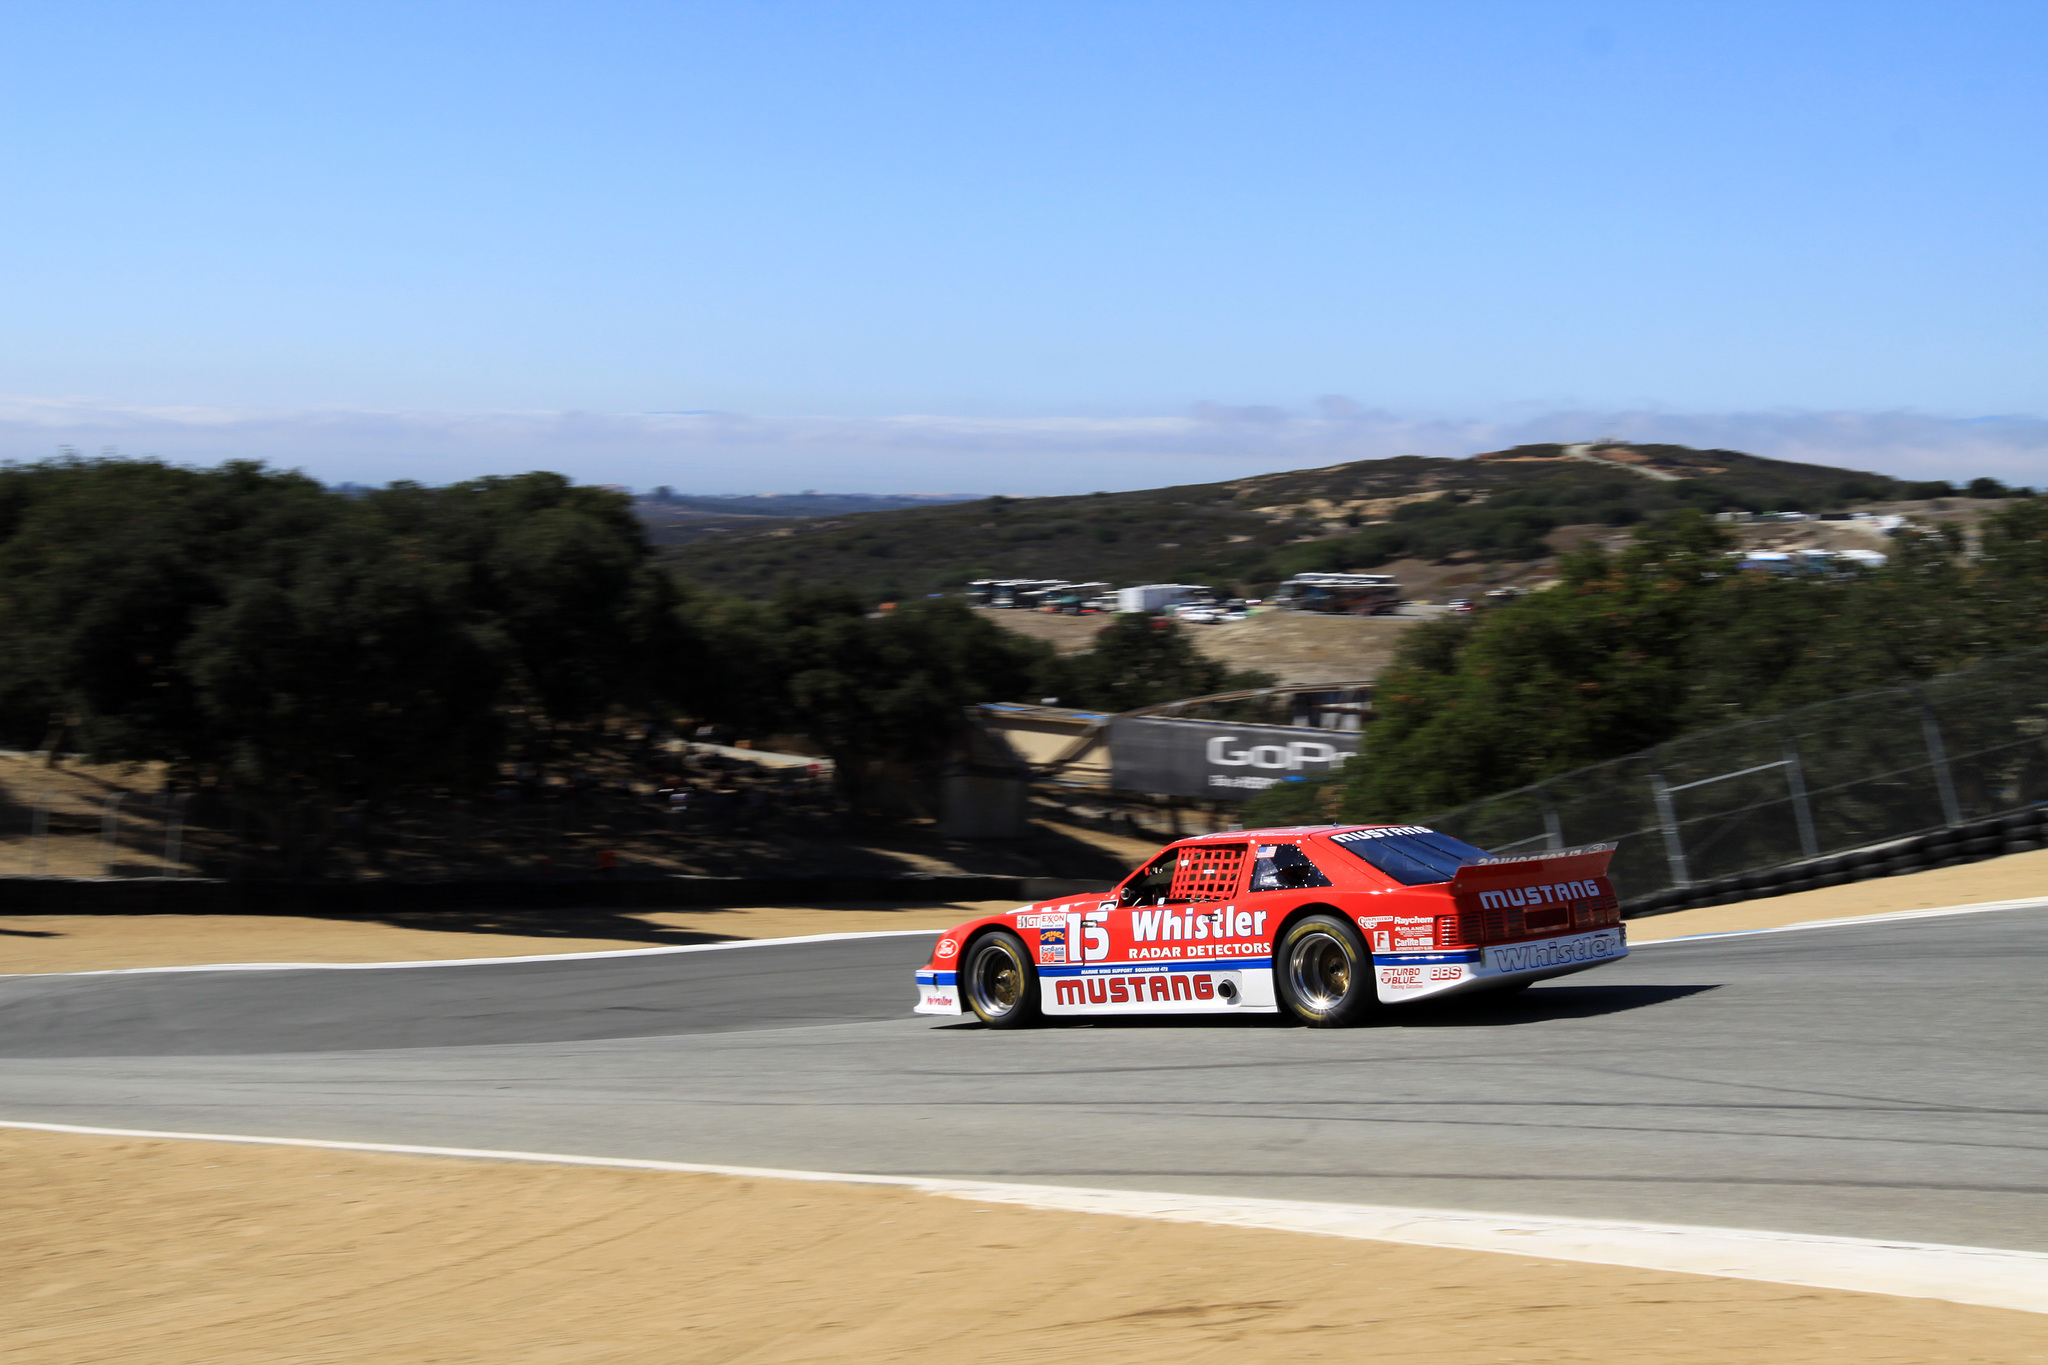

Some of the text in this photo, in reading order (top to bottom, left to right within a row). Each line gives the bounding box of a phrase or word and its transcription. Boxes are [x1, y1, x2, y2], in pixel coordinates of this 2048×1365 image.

[1331, 827, 1433, 843] MUSTANG
[1478, 879, 1601, 910] MUSTANG
[1027, 916, 1040, 926] GT
[1042, 914, 1065, 924] EXXON
[1131, 905, 1268, 942] Whistler
[1394, 916, 1434, 925] Raychem
[1040, 931, 1065, 941] CAMEL
[1066, 911, 1110, 962] 15
[1377, 933, 1385, 947] F
[1394, 938, 1419, 946] Carlite
[939, 941, 954, 954] Ford
[1128, 942, 1272, 959] RADAR DETECTORS
[1042, 952, 1055, 962] 24
[1494, 937, 1615, 972] Whistler
[1383, 967, 1421, 976] TURBO
[1430, 966, 1462, 979] BBS
[1391, 976, 1423, 984] BLUE
[1055, 974, 1215, 1006] MUSTANG
